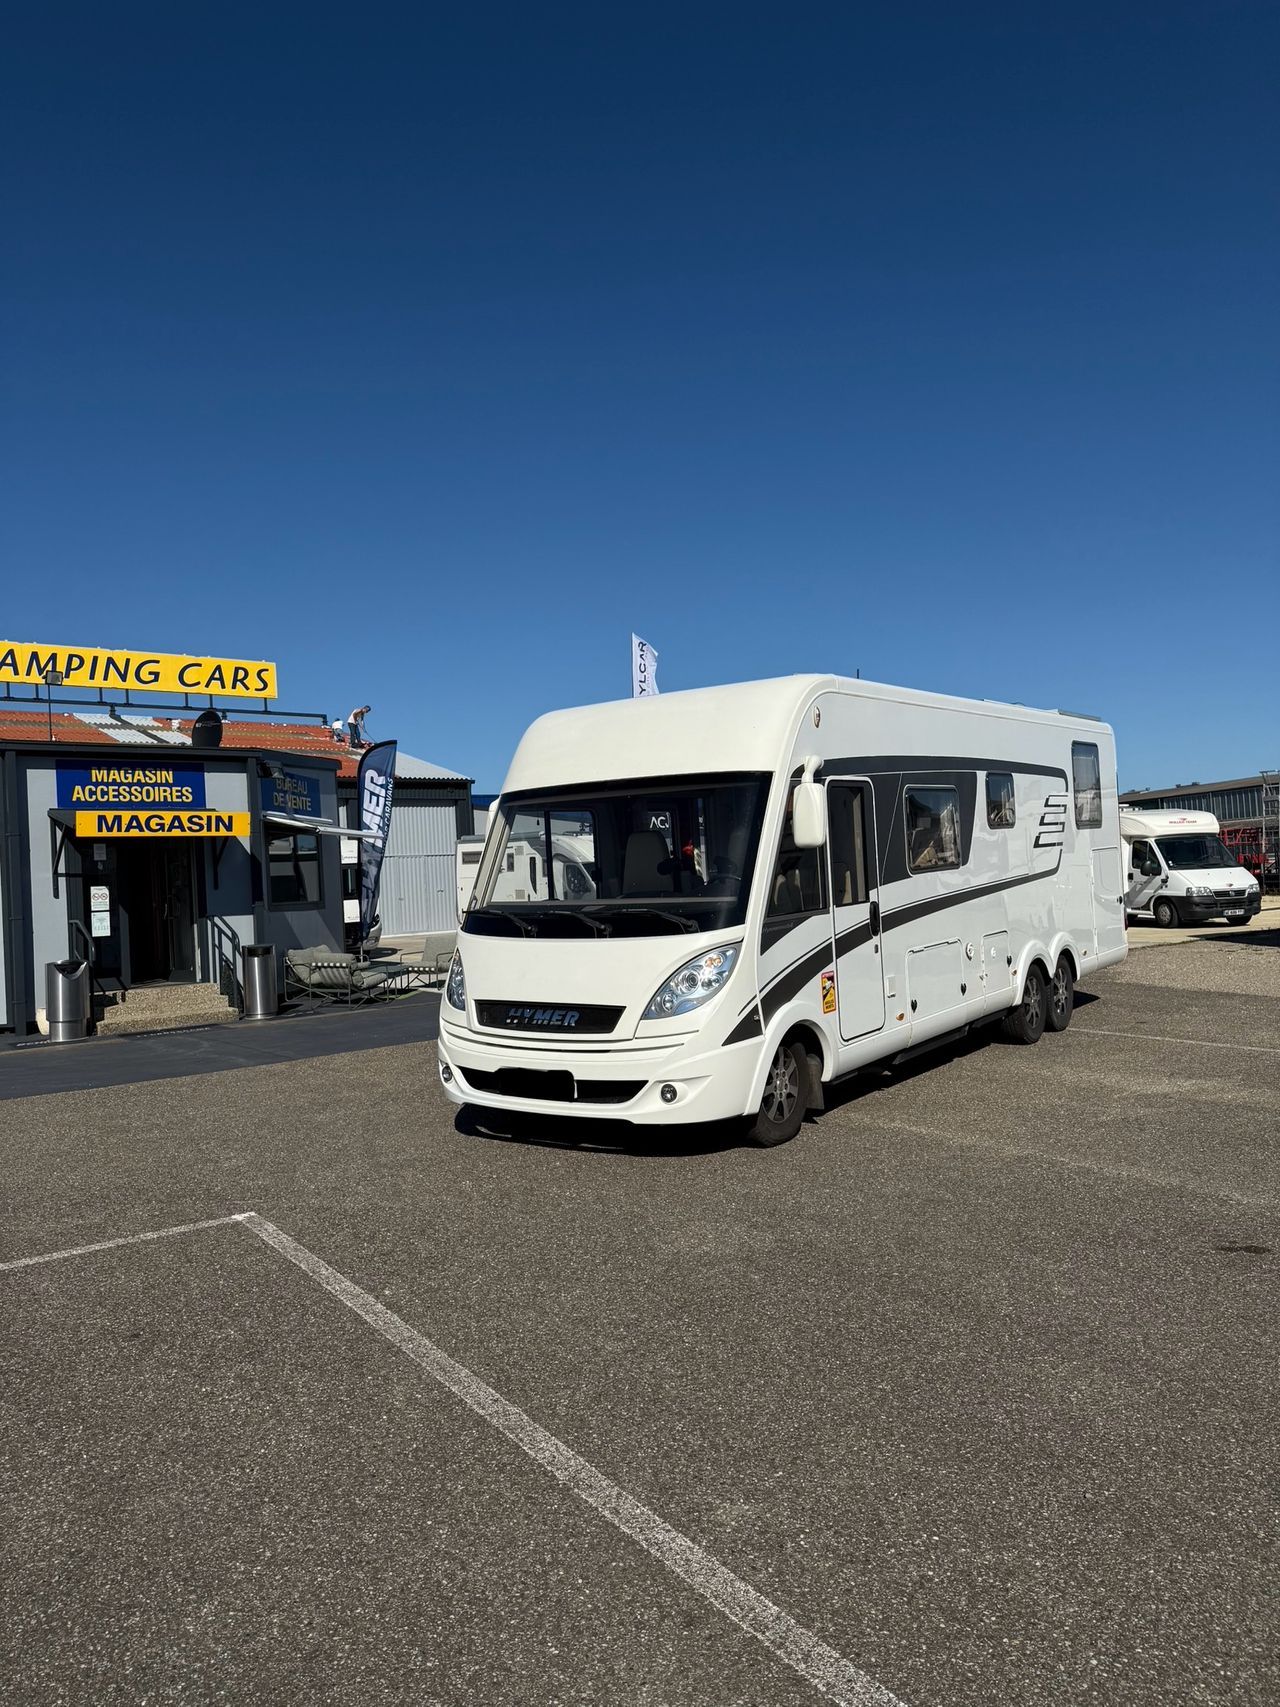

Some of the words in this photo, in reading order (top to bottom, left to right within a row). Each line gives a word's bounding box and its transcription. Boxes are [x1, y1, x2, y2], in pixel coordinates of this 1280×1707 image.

[177, 662, 270, 692] CARS
[91, 767, 174, 784] MAGASIN
[72, 786, 193, 803] ACCESSOIRES
[276, 778, 308, 795] BUREAU
[272, 792, 285, 807] DE
[286, 794, 312, 811] VENTE
[384, 777, 394, 827] CARAVANS
[97, 814, 234, 833] MAGASIN
[506, 1007, 580, 1027] HYMER
